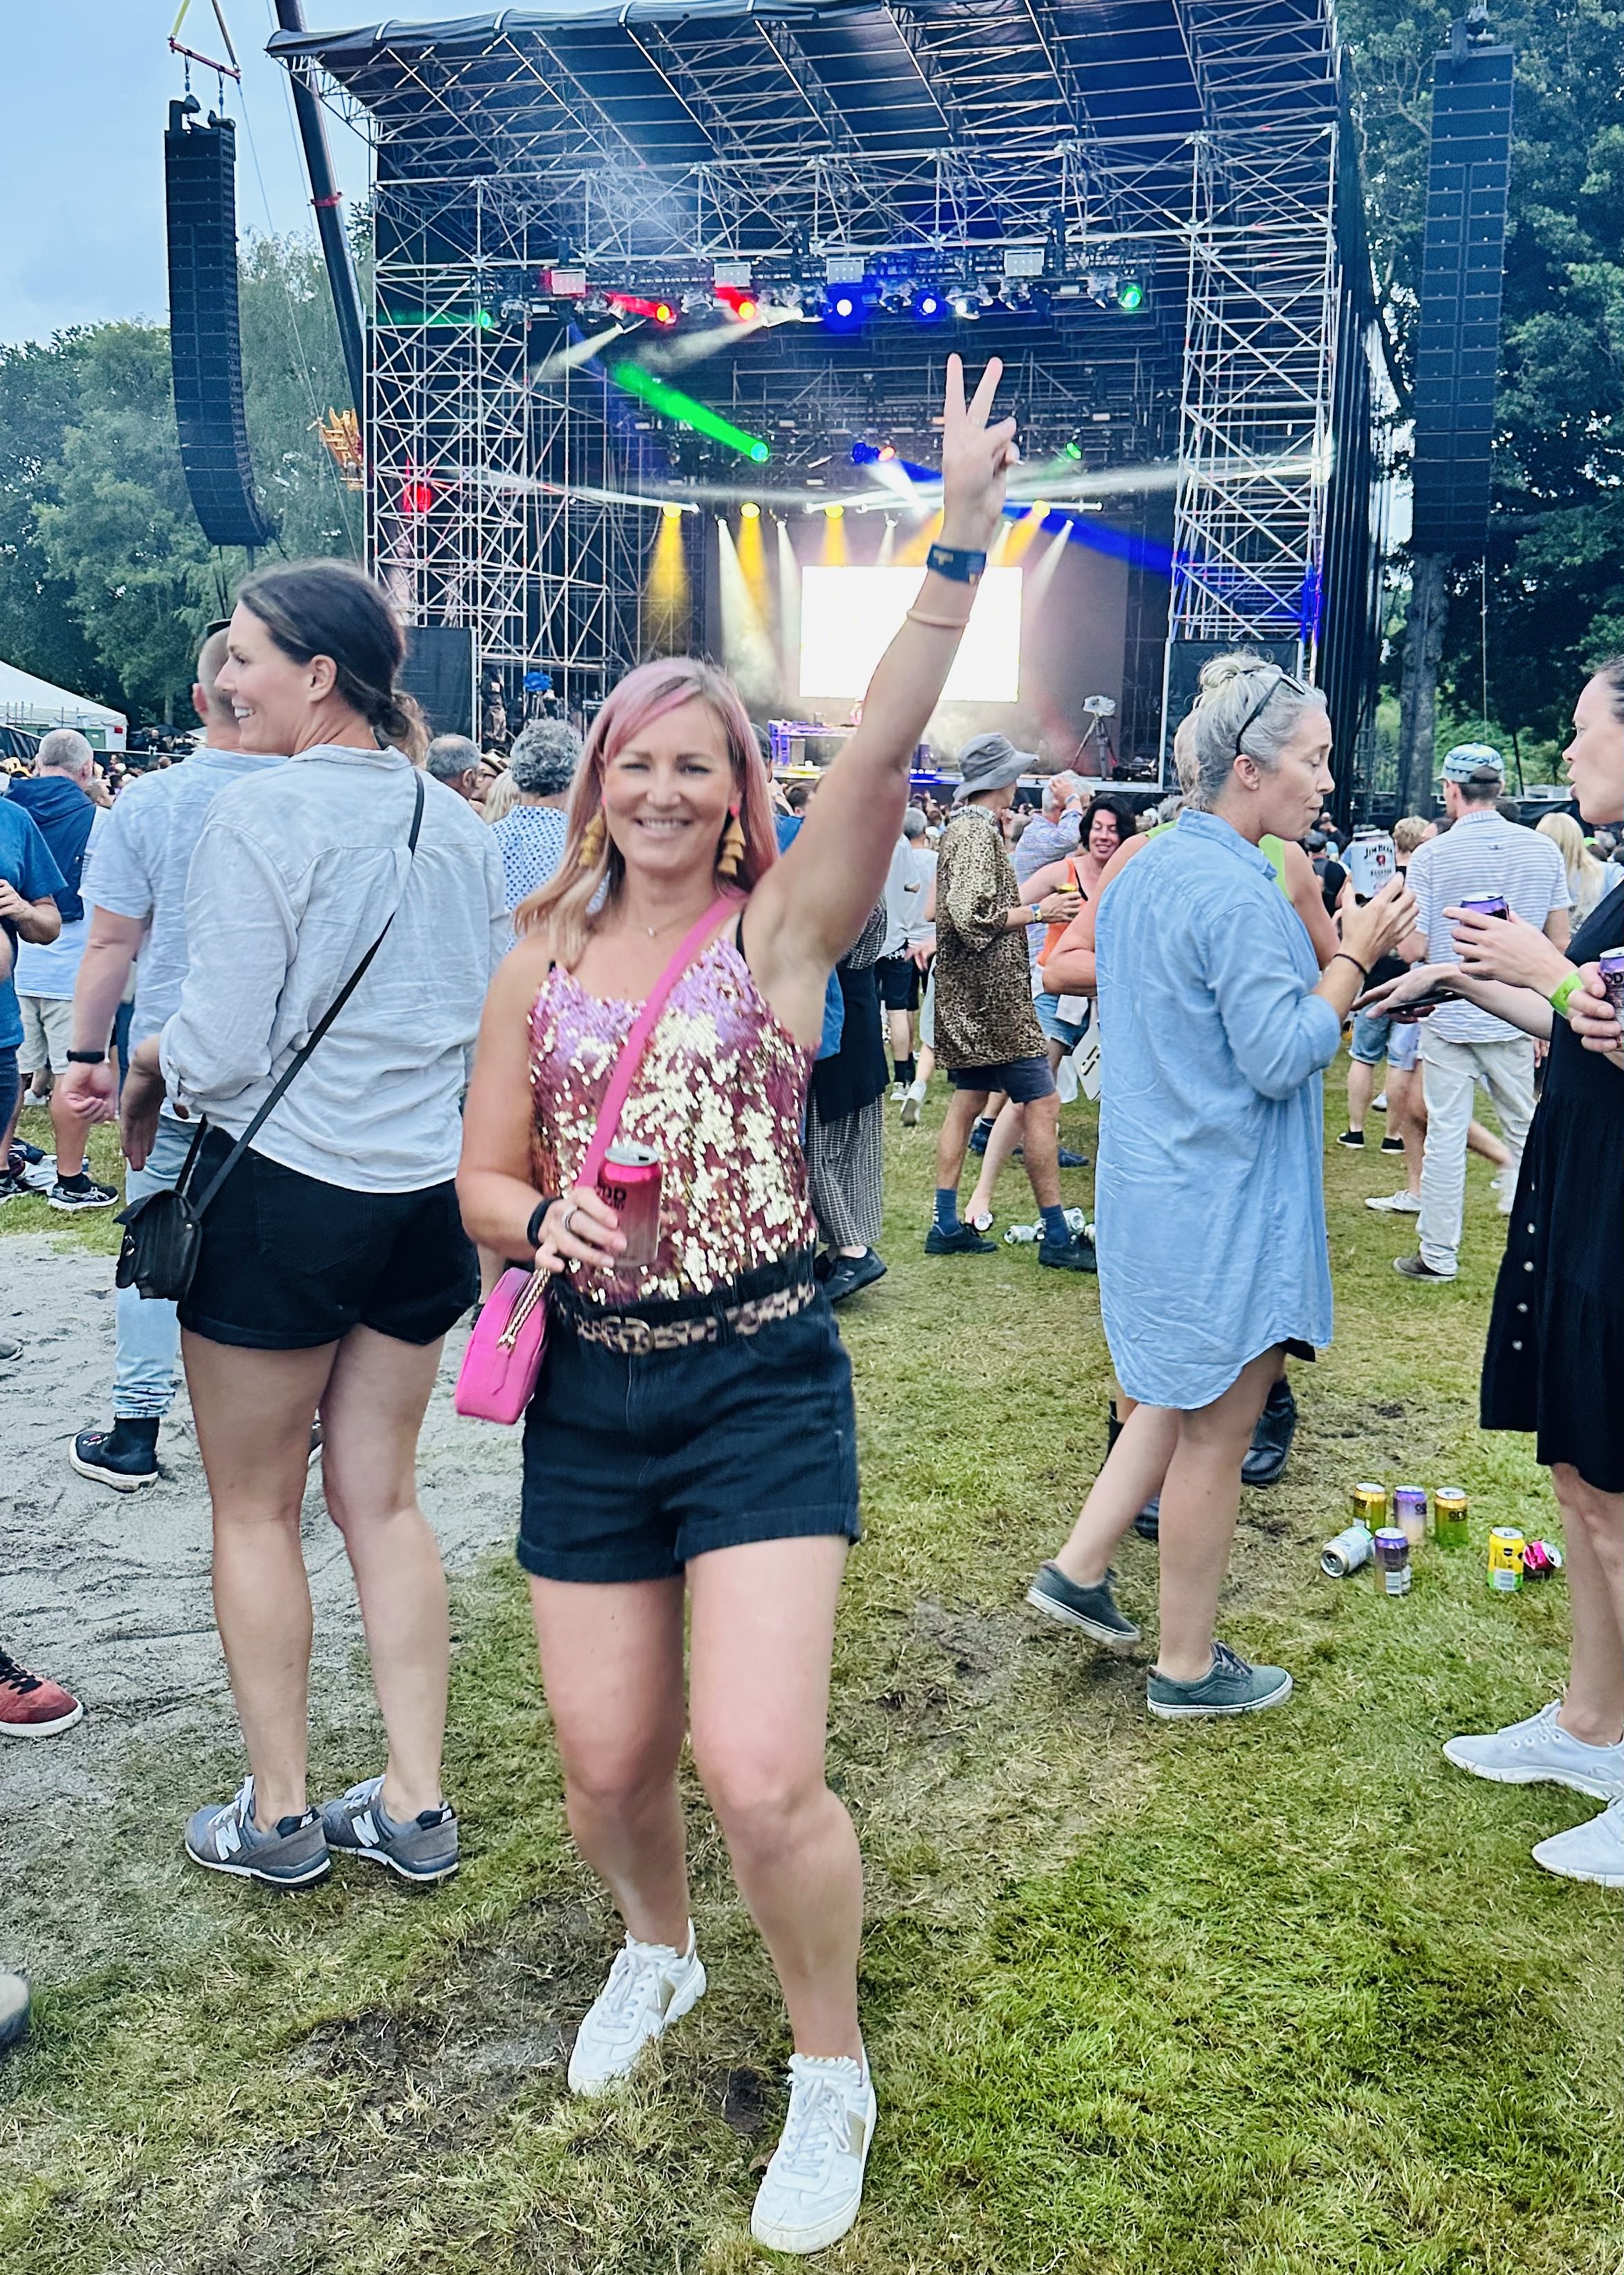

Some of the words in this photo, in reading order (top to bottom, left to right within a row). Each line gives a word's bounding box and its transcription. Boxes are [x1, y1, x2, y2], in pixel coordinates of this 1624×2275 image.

[1364, 847, 1377, 859] JIM
[1604, 972, 1624, 984] OD
[215, 1818, 242, 1861] N
[351, 1810, 380, 1848] N
